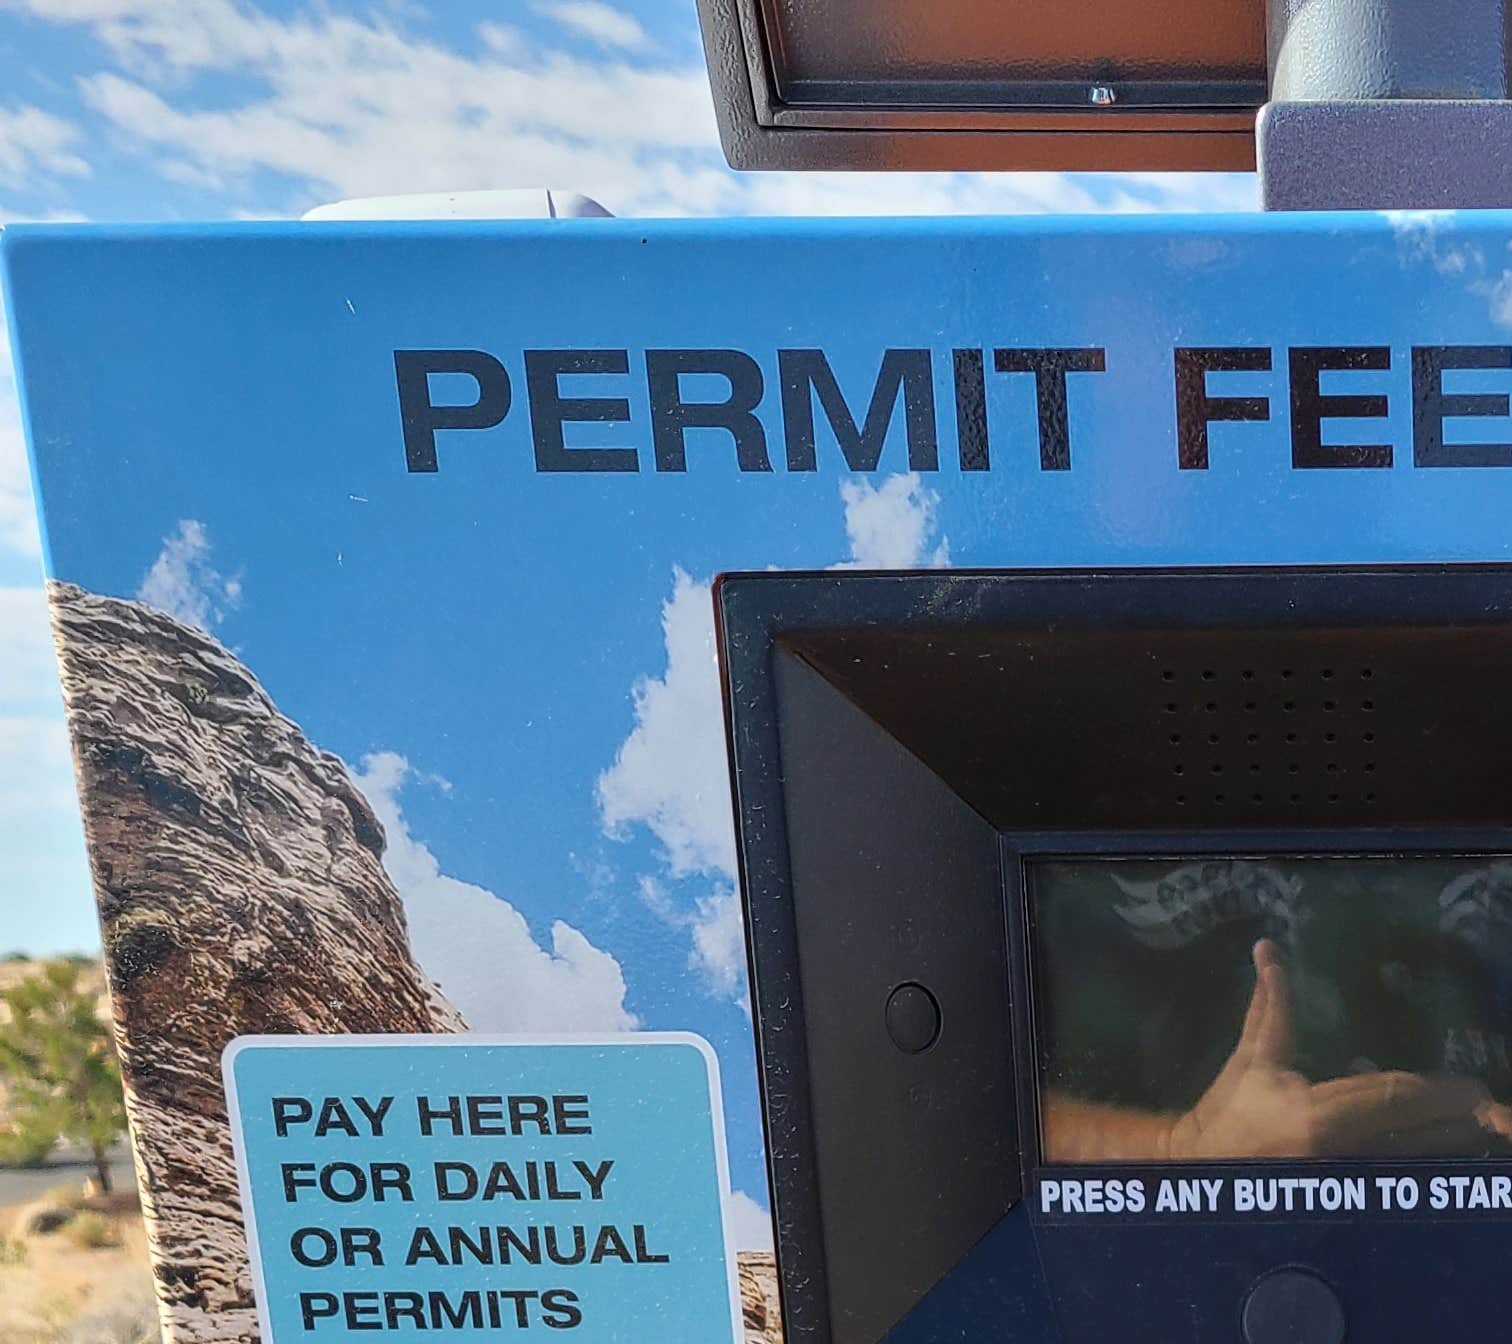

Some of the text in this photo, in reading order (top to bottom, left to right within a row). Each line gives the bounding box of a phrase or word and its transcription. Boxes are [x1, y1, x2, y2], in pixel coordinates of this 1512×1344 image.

[393, 347, 1107, 474] PERMIT
[271, 1094, 593, 1138] PAY HERE
[280, 1160, 616, 1203] FOR DAILY
[1040, 1180, 1145, 1213] PRESS
[1155, 1179, 1223, 1211] ANY
[1233, 1178, 1367, 1211] BUTTON
[1375, 1177, 1420, 1210] TO
[289, 1225, 670, 1267] OR ANNUAL
[299, 1289, 582, 1331] PERMITS
